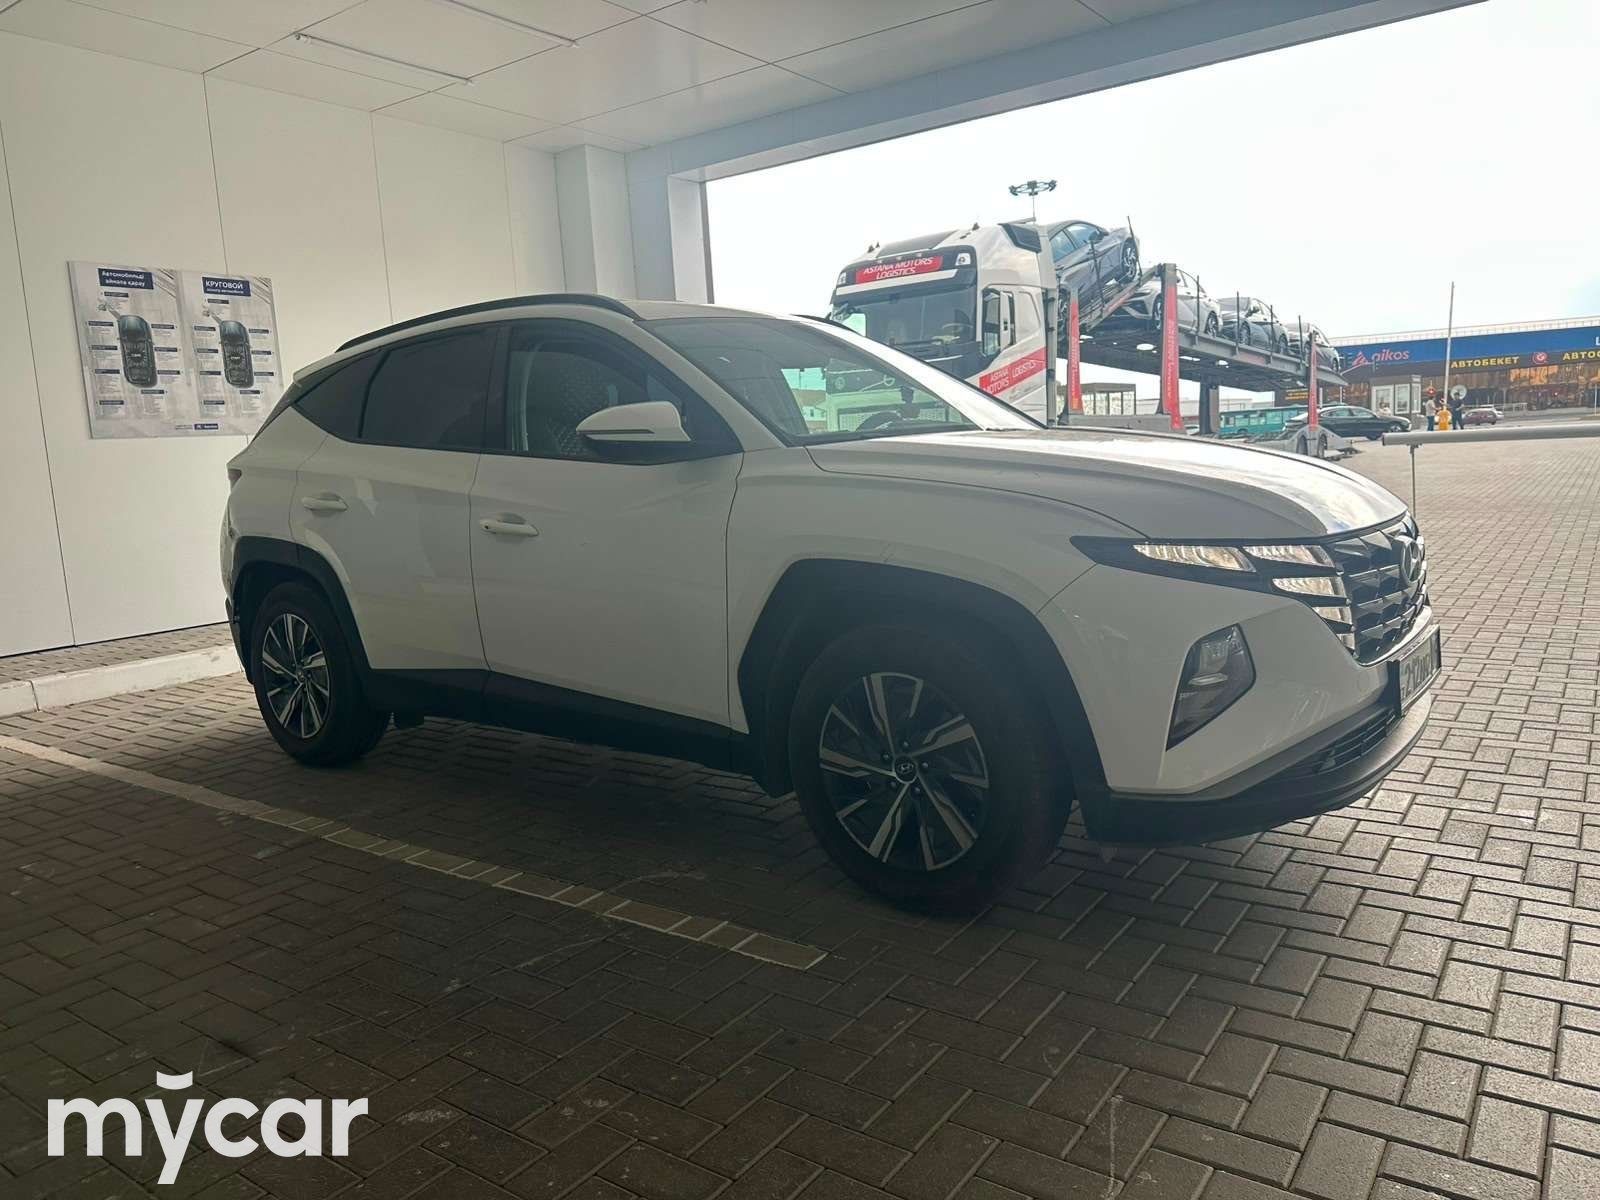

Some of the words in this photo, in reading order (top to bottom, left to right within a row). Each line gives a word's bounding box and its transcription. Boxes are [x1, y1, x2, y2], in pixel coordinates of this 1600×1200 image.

[863, 264, 894, 274] ASTANA
[894, 257, 934, 269] MOTORS
[876, 267, 916, 280] LOGISTICS
[205, 280, 243, 290] КРУГОВОЙ
[1450, 356, 1520, 369] АВТОБЕКЕТ
